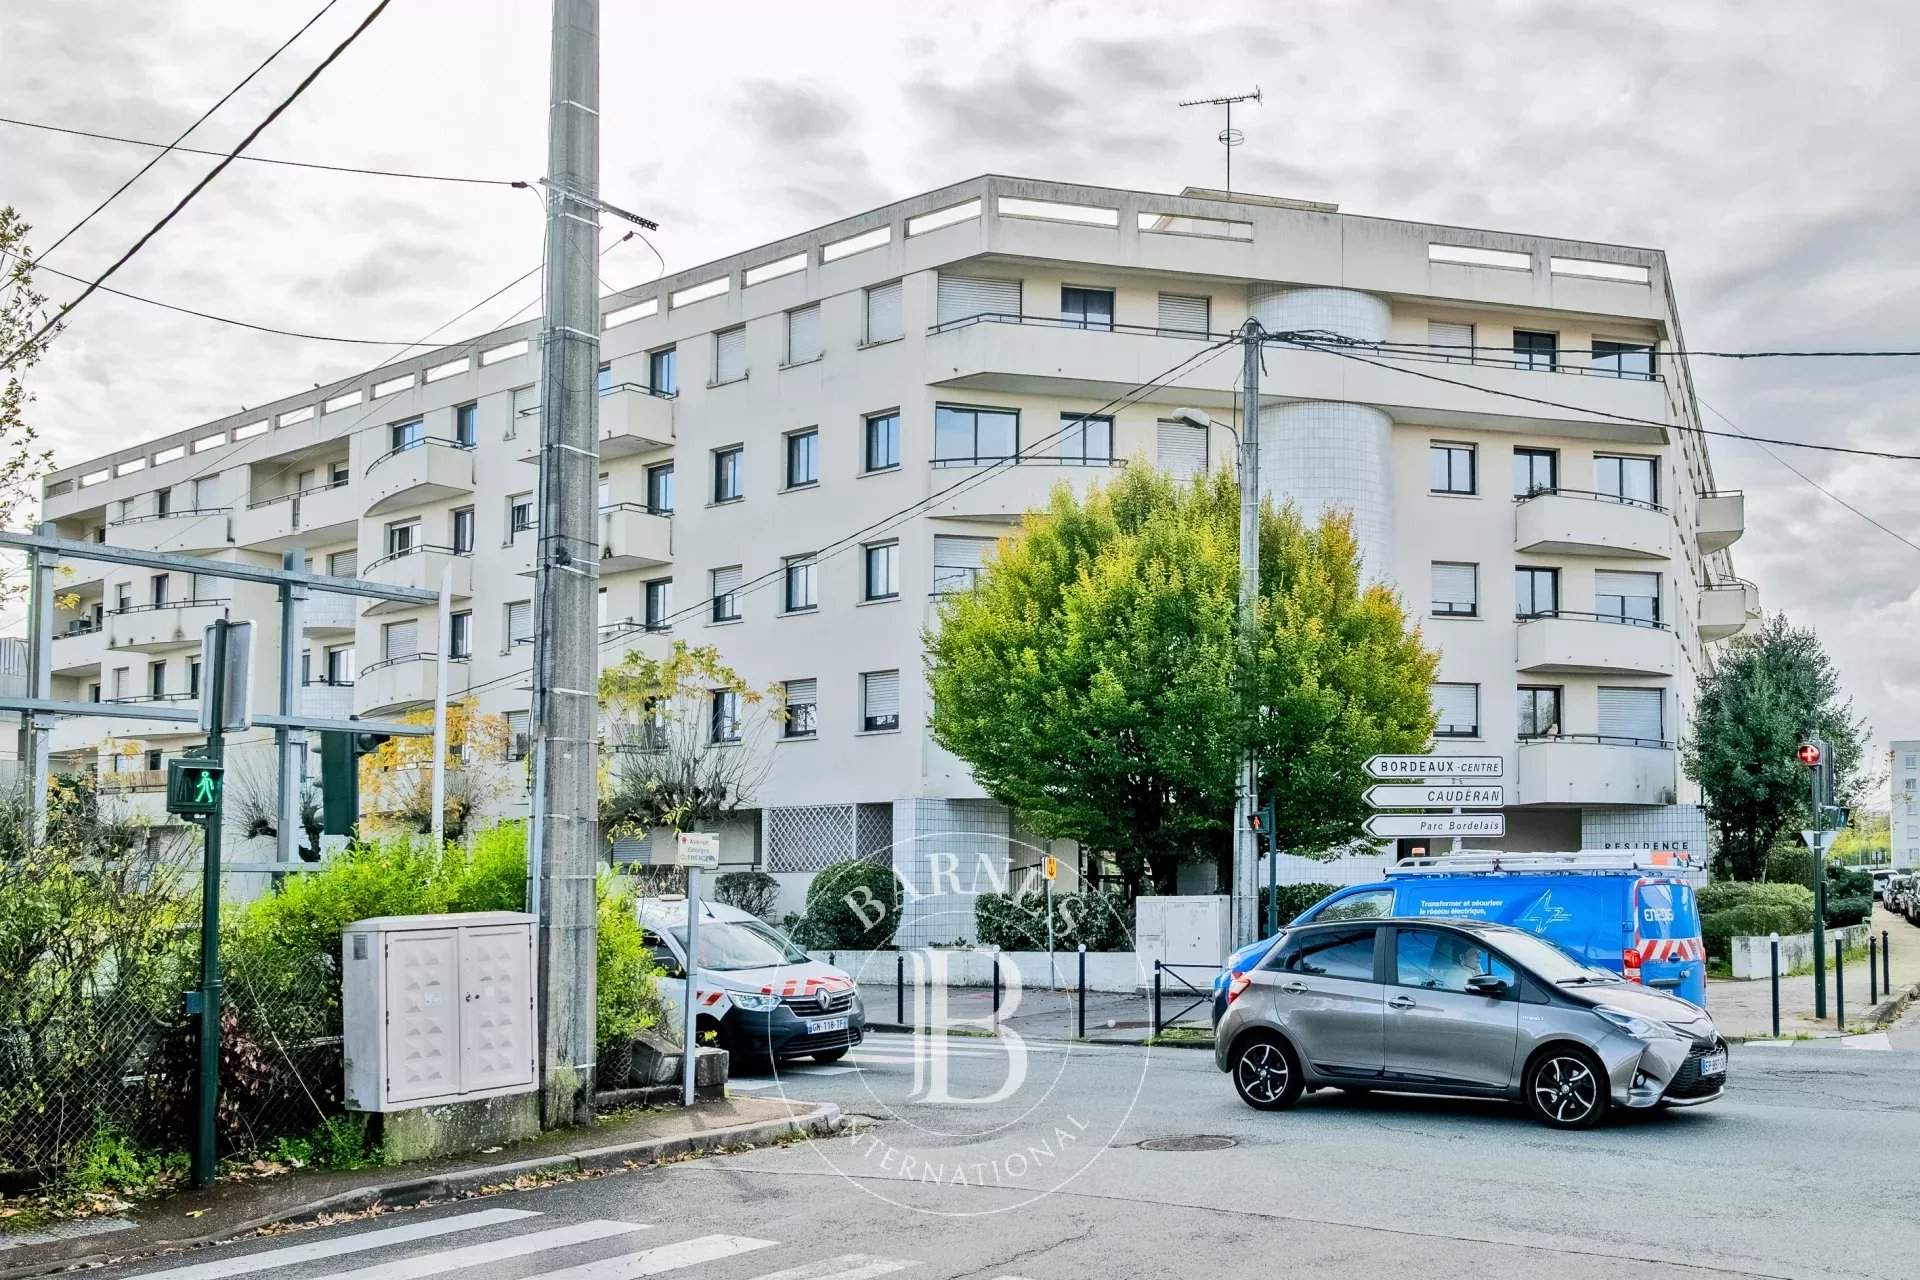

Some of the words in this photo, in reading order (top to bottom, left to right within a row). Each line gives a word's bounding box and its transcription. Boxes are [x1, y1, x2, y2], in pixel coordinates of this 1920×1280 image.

[1381, 761, 1454, 772] BORDEAUX
[1420, 821, 1443, 830] Parc
[1449, 821, 1499, 830] Bordelais
[1605, 842, 1689, 850] RESIDENCE
